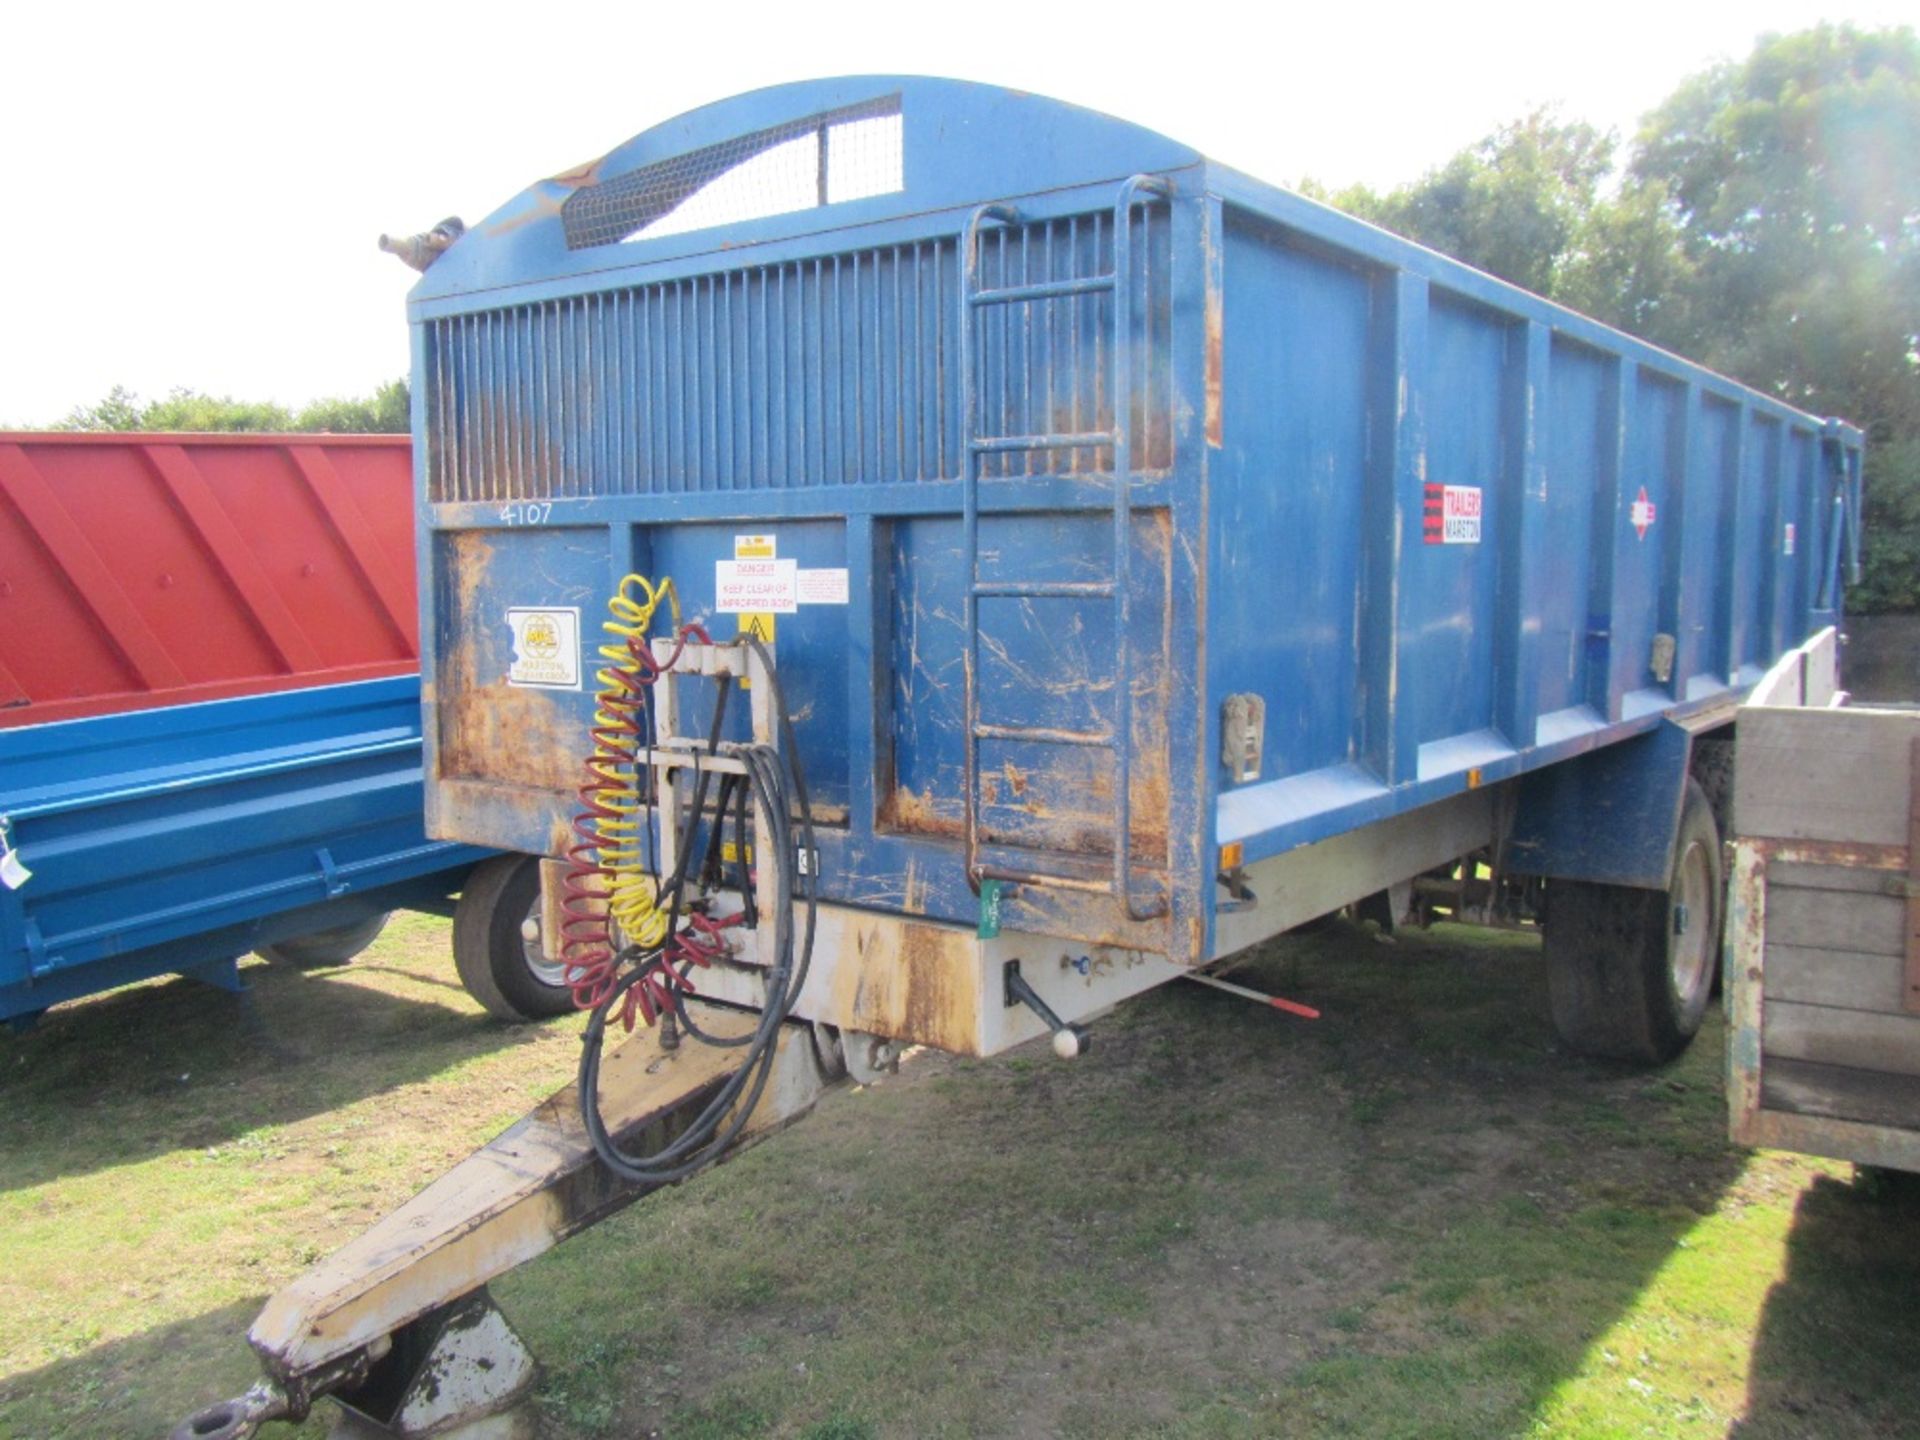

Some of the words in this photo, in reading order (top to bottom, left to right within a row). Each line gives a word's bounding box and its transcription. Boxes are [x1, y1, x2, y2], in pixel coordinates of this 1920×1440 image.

[1445, 491, 1480, 516] TRAILERS
[500, 502, 552, 527] 4107
[1445, 519, 1479, 538] MARSTON
[736, 563, 776, 574] DANGER
[723, 584, 743, 594] KEEP
[746, 584, 774, 594] CLEAR
